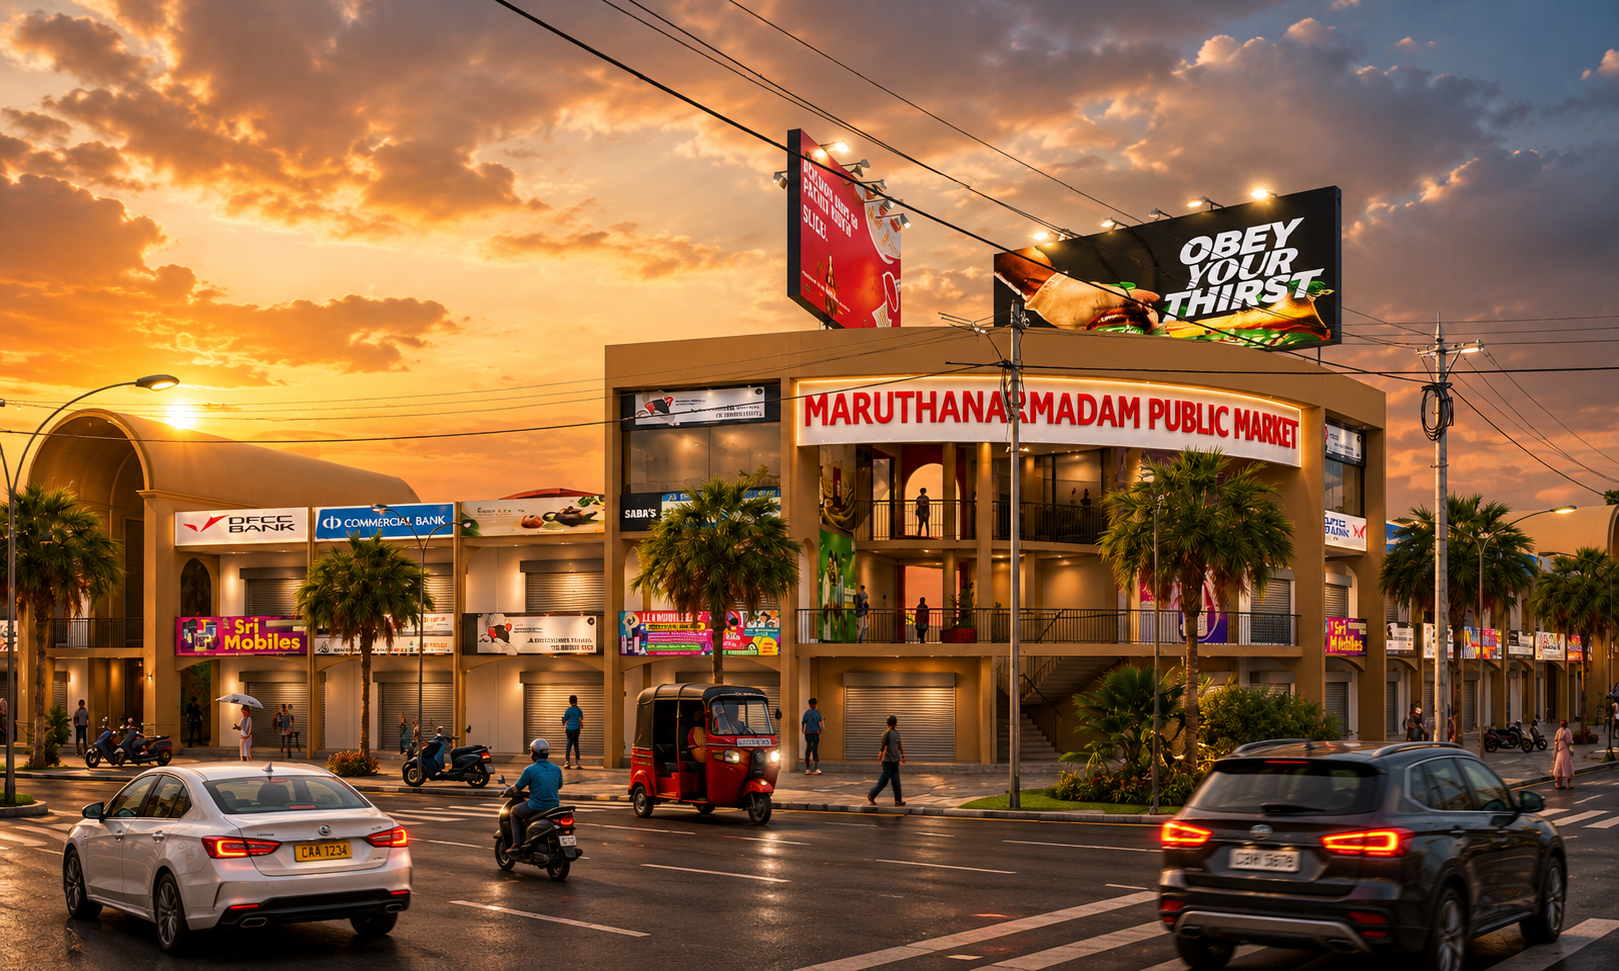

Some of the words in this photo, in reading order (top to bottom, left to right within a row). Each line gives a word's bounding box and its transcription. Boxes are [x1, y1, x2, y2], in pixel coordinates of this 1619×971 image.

[1179, 217, 1305, 266] OBEY
[1186, 247, 1299, 290] YOUR
[1162, 268, 1325, 323] THIRST
[1148, 398, 1229, 438] PUBLIC
[1234, 407, 1299, 450] MARKET
[228, 515, 293, 525] DFCC
[344, 516, 412, 528] COMMERCIAL
[415, 515, 446, 526] BANK
[625, 508, 657, 519] SABA'S
[228, 523, 295, 533] BANK
[234, 618, 259, 634] Sri
[224, 633, 301, 650] Mobiles
[301, 846, 322, 858] CAA
[325, 844, 348, 856] 1234
